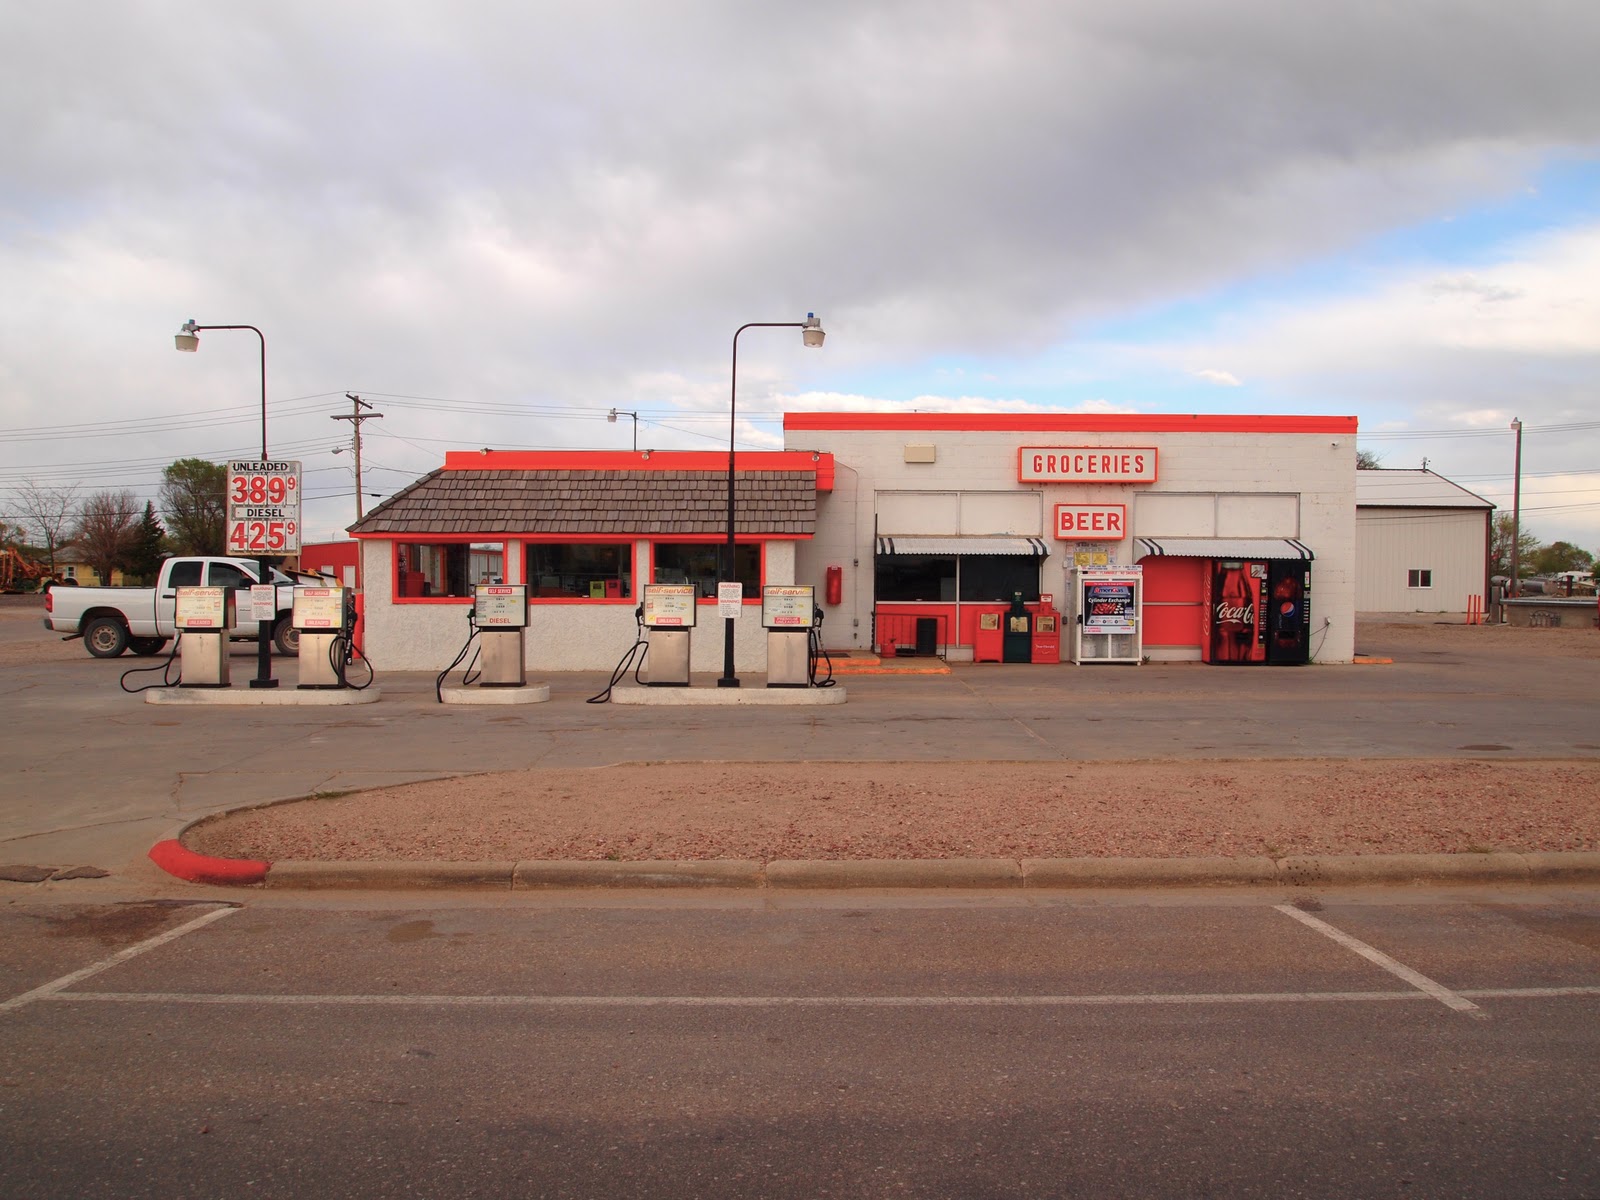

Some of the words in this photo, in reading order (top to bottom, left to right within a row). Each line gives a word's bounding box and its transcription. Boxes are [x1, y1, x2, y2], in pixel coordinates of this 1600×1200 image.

[233, 463, 289, 471] UNLEADED
[1033, 455, 1144, 473] GROCERIES
[231, 476, 285, 504] 389
[246, 508, 285, 517] DIESEL
[1061, 512, 1121, 531] BEER
[230, 522, 285, 549] 425
